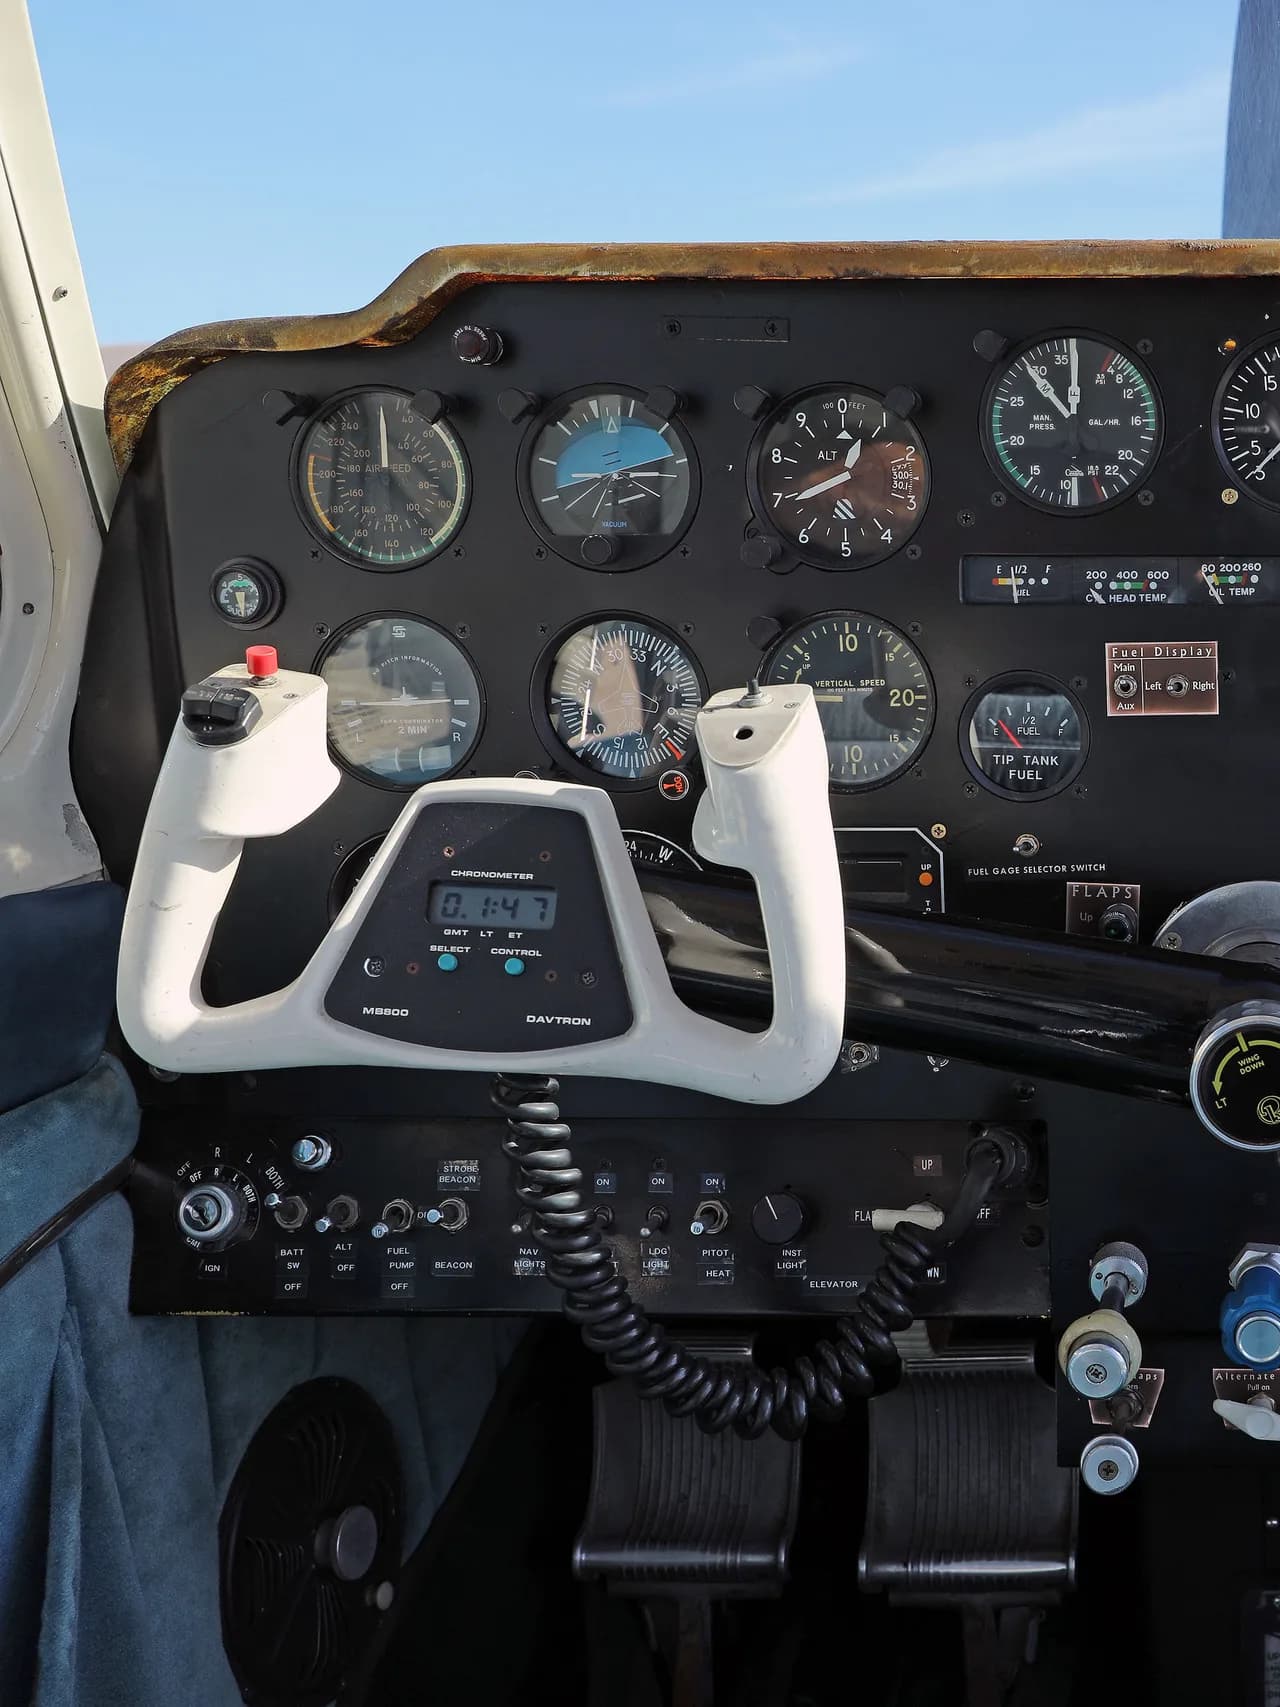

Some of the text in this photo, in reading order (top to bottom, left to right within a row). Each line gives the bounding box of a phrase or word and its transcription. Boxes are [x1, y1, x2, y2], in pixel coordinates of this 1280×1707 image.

[1010, 397, 1024, 406] 25
[818, 451, 837, 460] ALT
[1229, 587, 1254, 596] TEMP
[1109, 593, 1167, 603] HEAD TEMP
[1112, 646, 1212, 658] Fuel Display
[1114, 663, 1135, 672] Main
[815, 679, 854, 687] VERTICAL
[1146, 681, 1161, 690] Left
[1193, 681, 1216, 692] Right
[890, 689, 914, 707] 20
[1117, 701, 1134, 711] Aux
[1017, 727, 1040, 735] FUEL
[993, 754, 1058, 766] TIP TANK
[1009, 769, 1042, 780] FUEL
[968, 864, 1106, 876] FUEL GAGE SELECTOR SWITCH
[451, 870, 533, 880] CHRONOMETER
[1072, 886, 1133, 899] FLAPS
[1080, 912, 1093, 922] Up
[430, 945, 471, 953] SELECT
[491, 948, 542, 957] CONTROL
[526, 1015, 591, 1025] DAVTRON
[1237, 1054, 1260, 1066] WING
[1239, 1060, 1265, 1075] DOWN
[443, 1165, 477, 1173] STROBE
[439, 1176, 476, 1184] BEACON
[336, 1243, 352, 1251] ALT
[387, 1247, 410, 1255] FUEL
[280, 1248, 304, 1256] BATT
[702, 1249, 728, 1257] PITOT
[205, 1264, 220, 1272] IGN
[287, 1262, 300, 1270] SW
[389, 1262, 414, 1270] PUMP
[435, 1261, 472, 1270] BEACON
[706, 1270, 730, 1278] HEAT
[810, 1280, 858, 1289] ELEVATOR
[1216, 1372, 1277, 1381] Alternate
